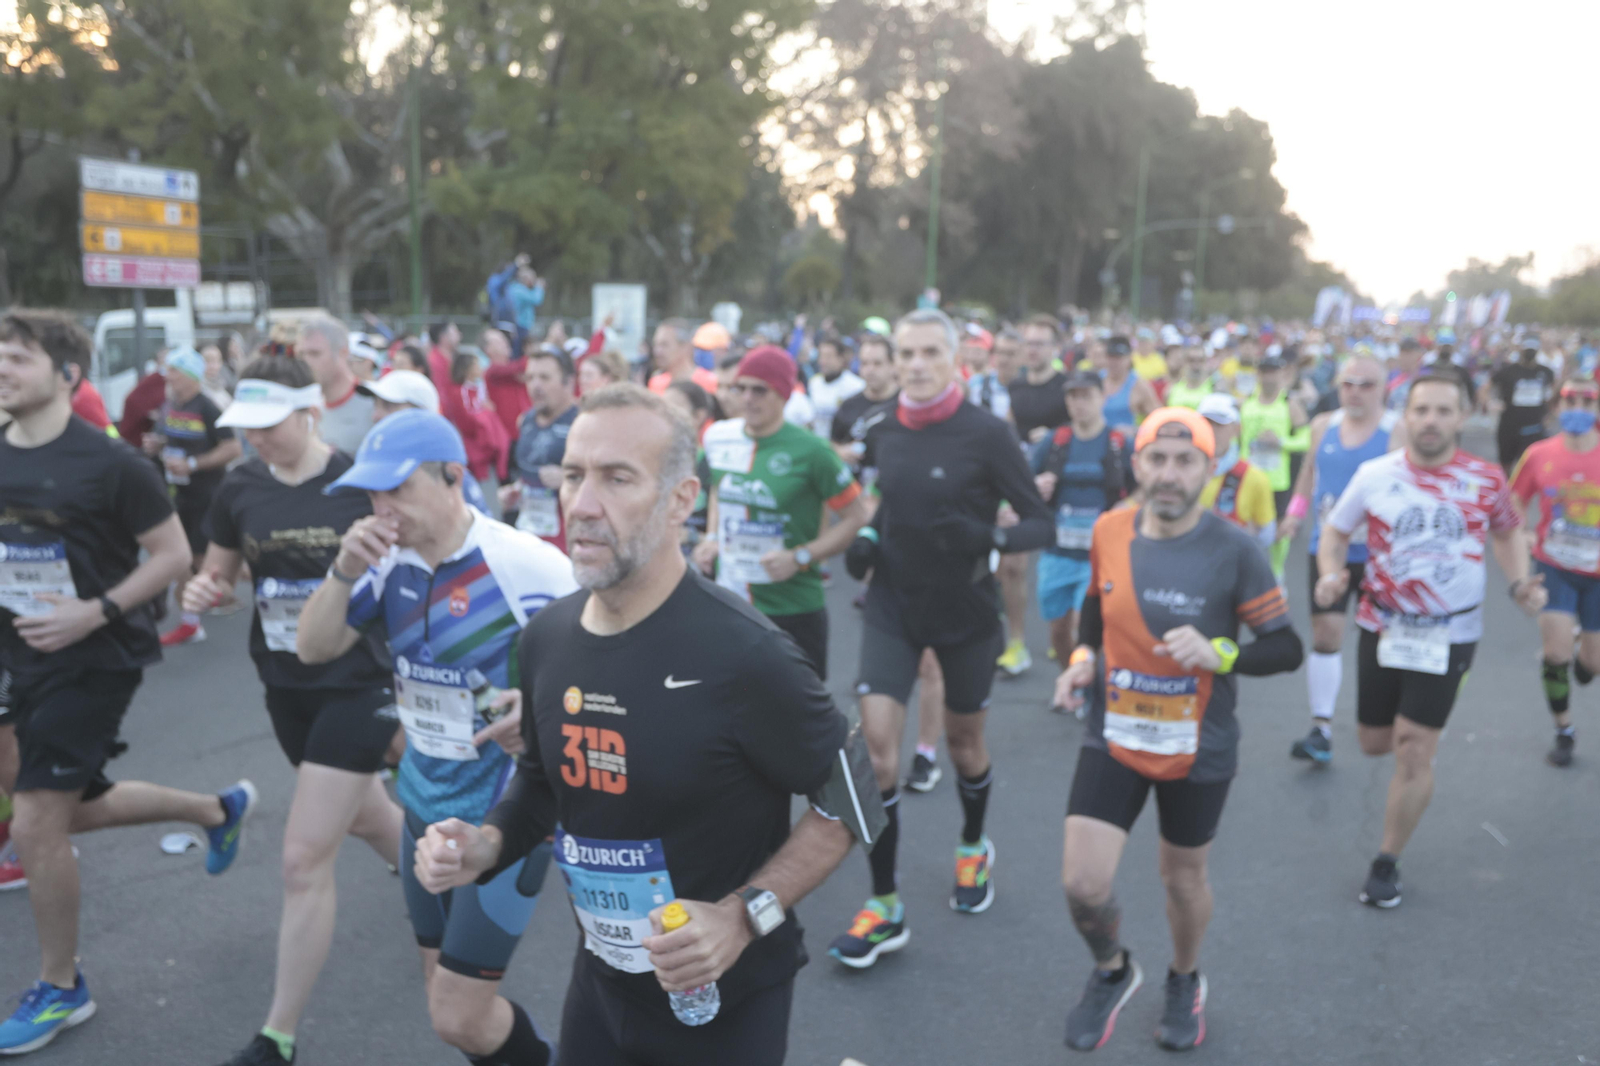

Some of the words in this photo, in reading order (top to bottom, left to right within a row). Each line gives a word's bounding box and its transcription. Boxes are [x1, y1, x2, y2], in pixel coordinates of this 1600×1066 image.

[411, 662, 461, 685] ZURICH
[1132, 676, 1187, 694] ZURICH
[579, 845, 647, 866] ZURICH
[582, 888, 629, 911] 11310
